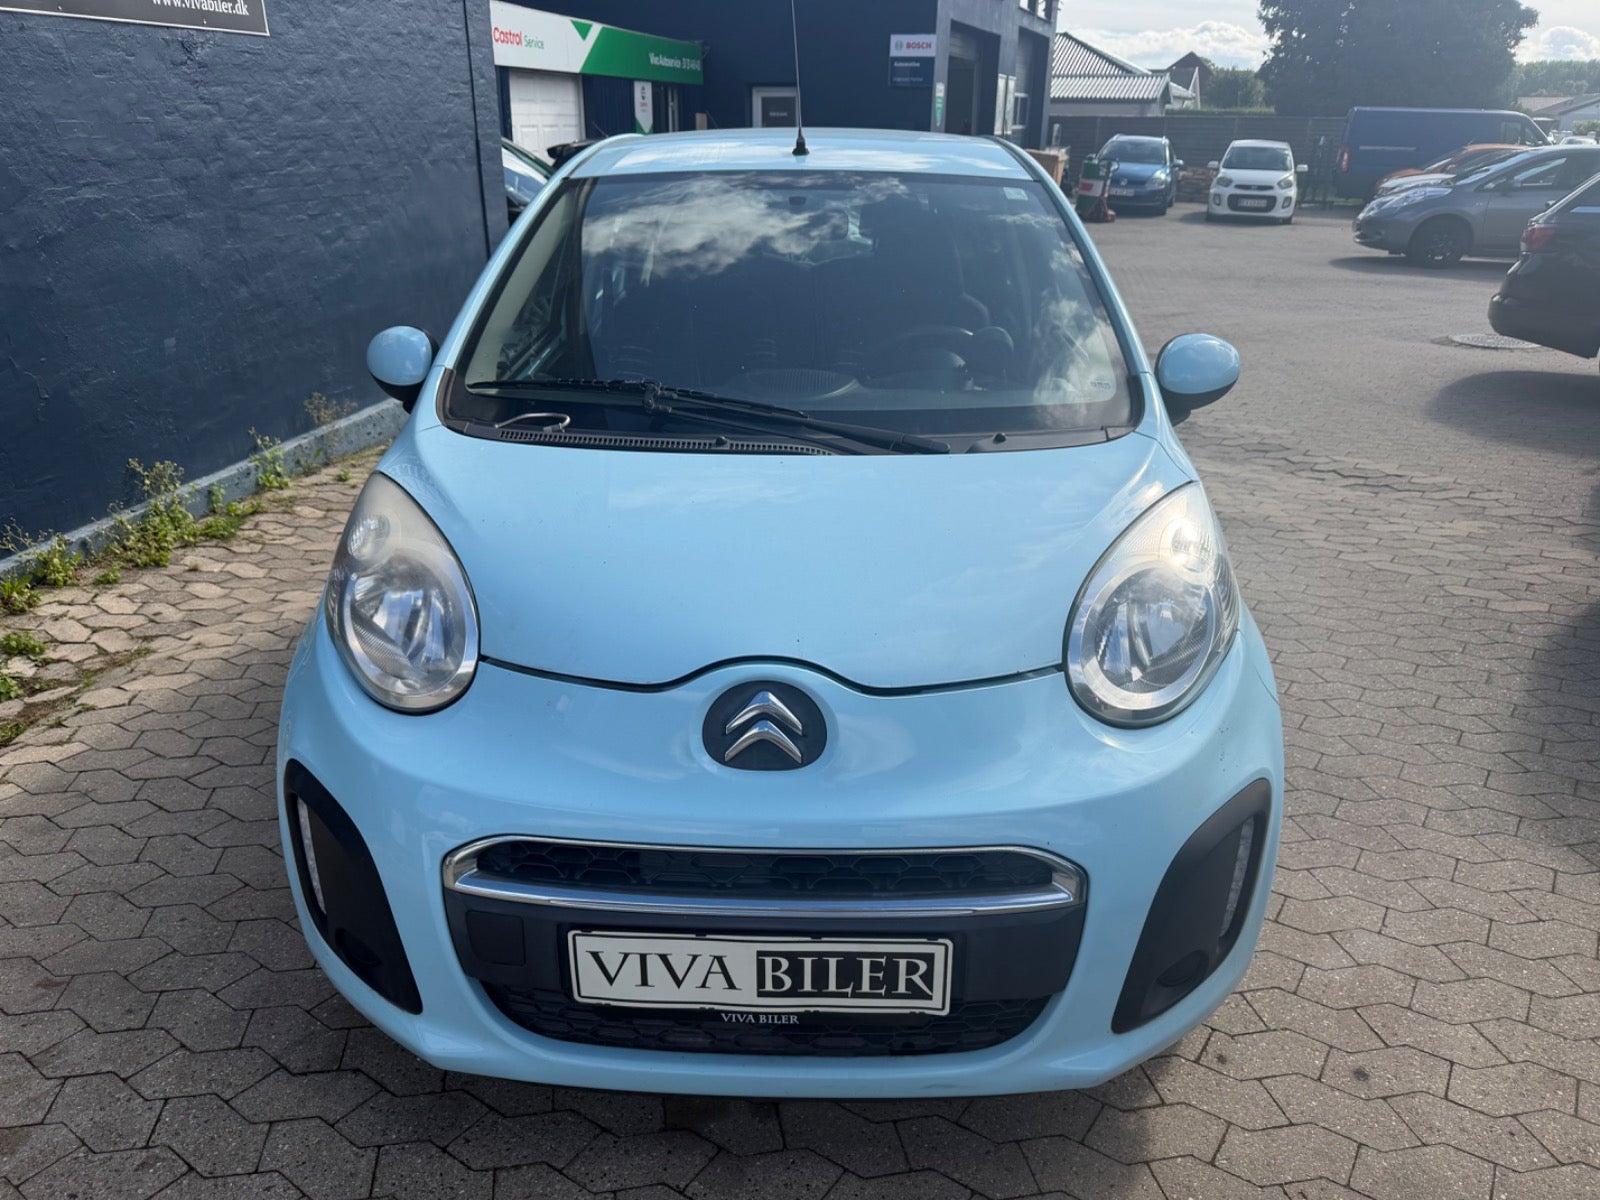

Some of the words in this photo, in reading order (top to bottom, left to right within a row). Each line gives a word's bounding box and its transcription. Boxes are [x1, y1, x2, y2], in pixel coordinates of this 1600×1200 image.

[493, 26, 523, 47] Castrol
[524, 35, 545, 49] Service
[905, 41, 932, 49] BOSCH
[585, 950, 743, 991] VIVA
[758, 955, 934, 998] BILER
[720, 1012, 756, 1024] VIVA
[758, 1013, 799, 1025] BILER
